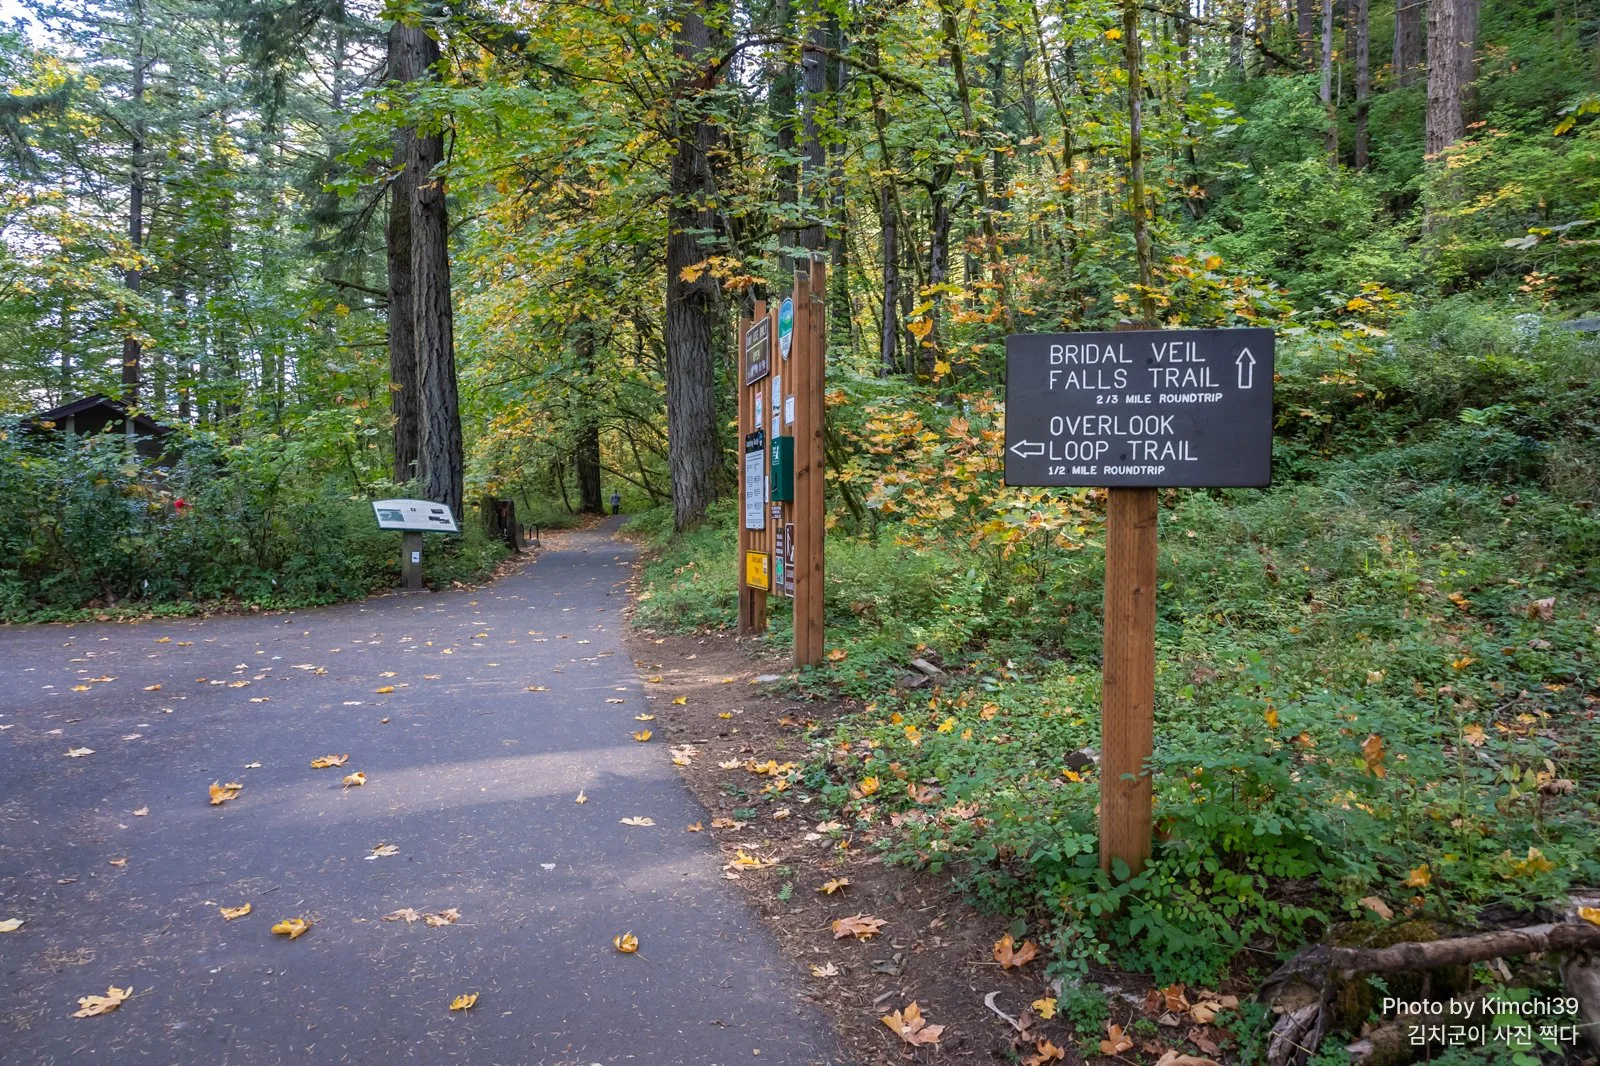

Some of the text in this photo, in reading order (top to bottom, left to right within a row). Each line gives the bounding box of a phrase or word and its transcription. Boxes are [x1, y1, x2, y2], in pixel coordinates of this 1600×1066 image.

[1050, 342, 1206, 365] BRIDAL VEIL
[1049, 367, 1219, 390] FALLS TRAIL
[1096, 393, 1223, 404] 2/3 MILE ROUNDTRIP
[1050, 414, 1175, 436] OVERLOOK
[1049, 440, 1198, 461] LOOP TRAIL
[1048, 465, 1165, 475] 1/2 MILE ROUNDTRIP
